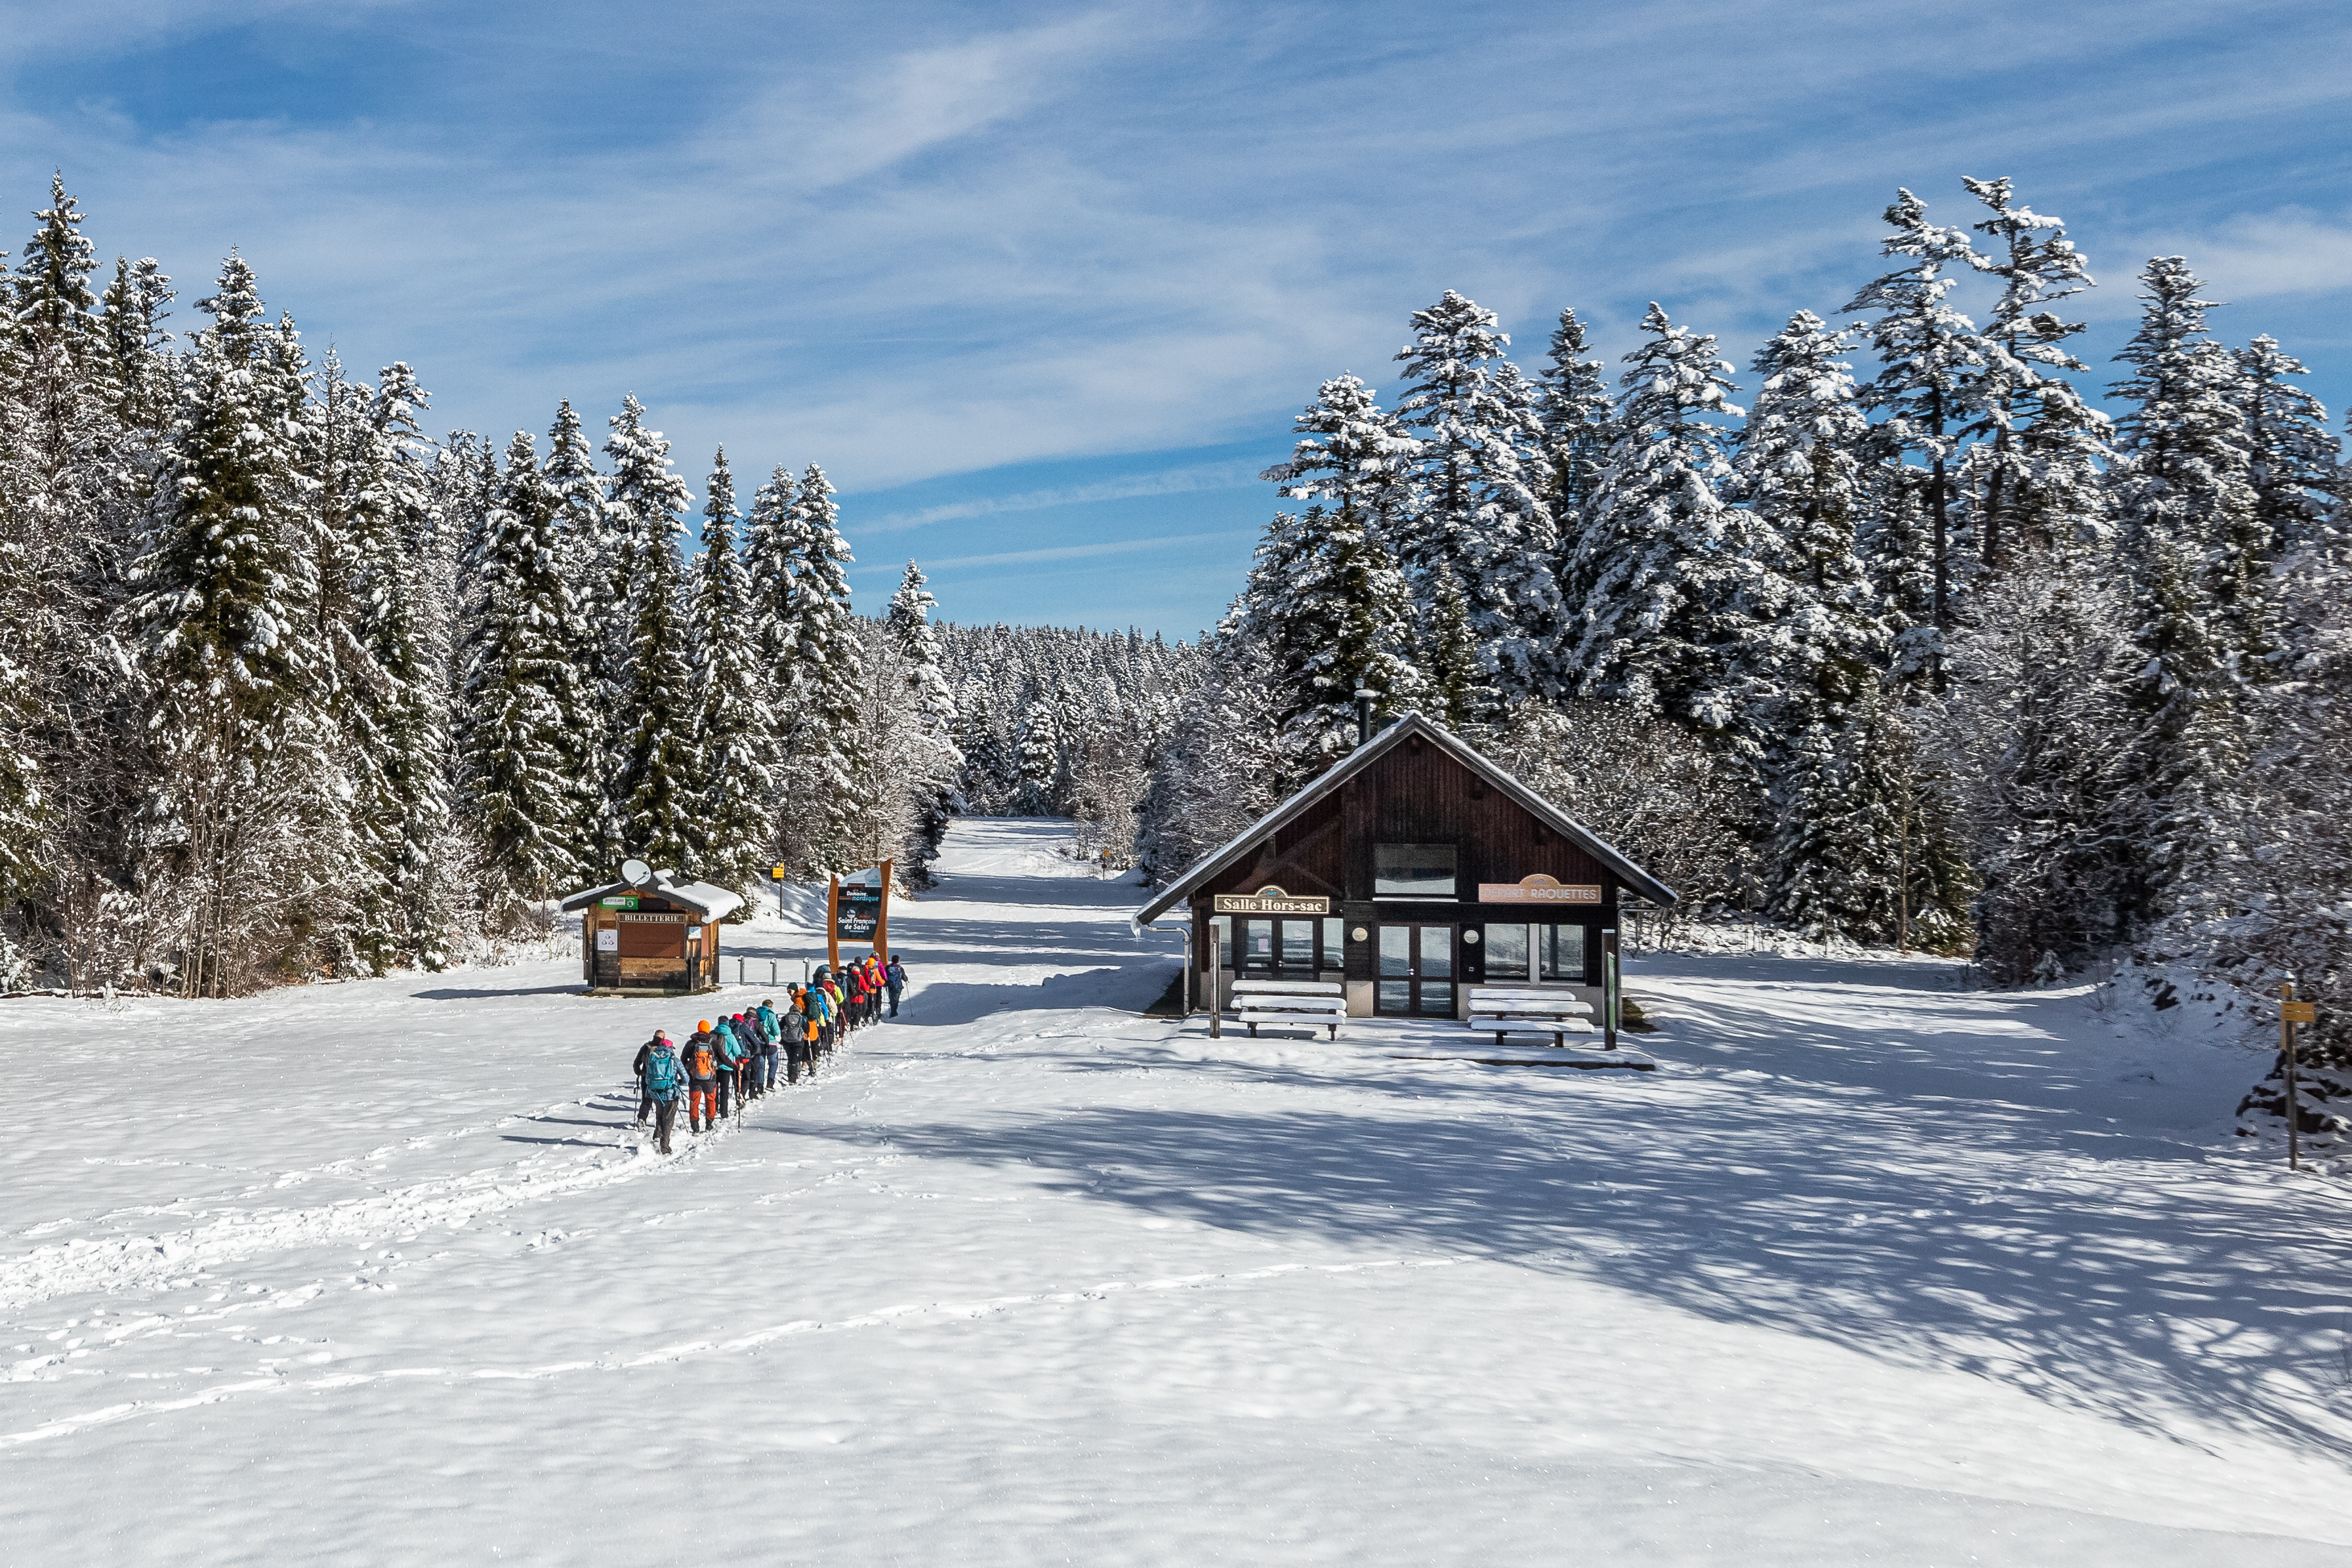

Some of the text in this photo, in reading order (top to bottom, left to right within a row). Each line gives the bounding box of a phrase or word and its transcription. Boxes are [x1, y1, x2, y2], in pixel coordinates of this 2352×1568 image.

[1531, 889, 1597, 899] RAQUETTES
[1223, 898, 1322, 911] Salle Hors-sac
[625, 914, 680, 922] BILLETTERIE
